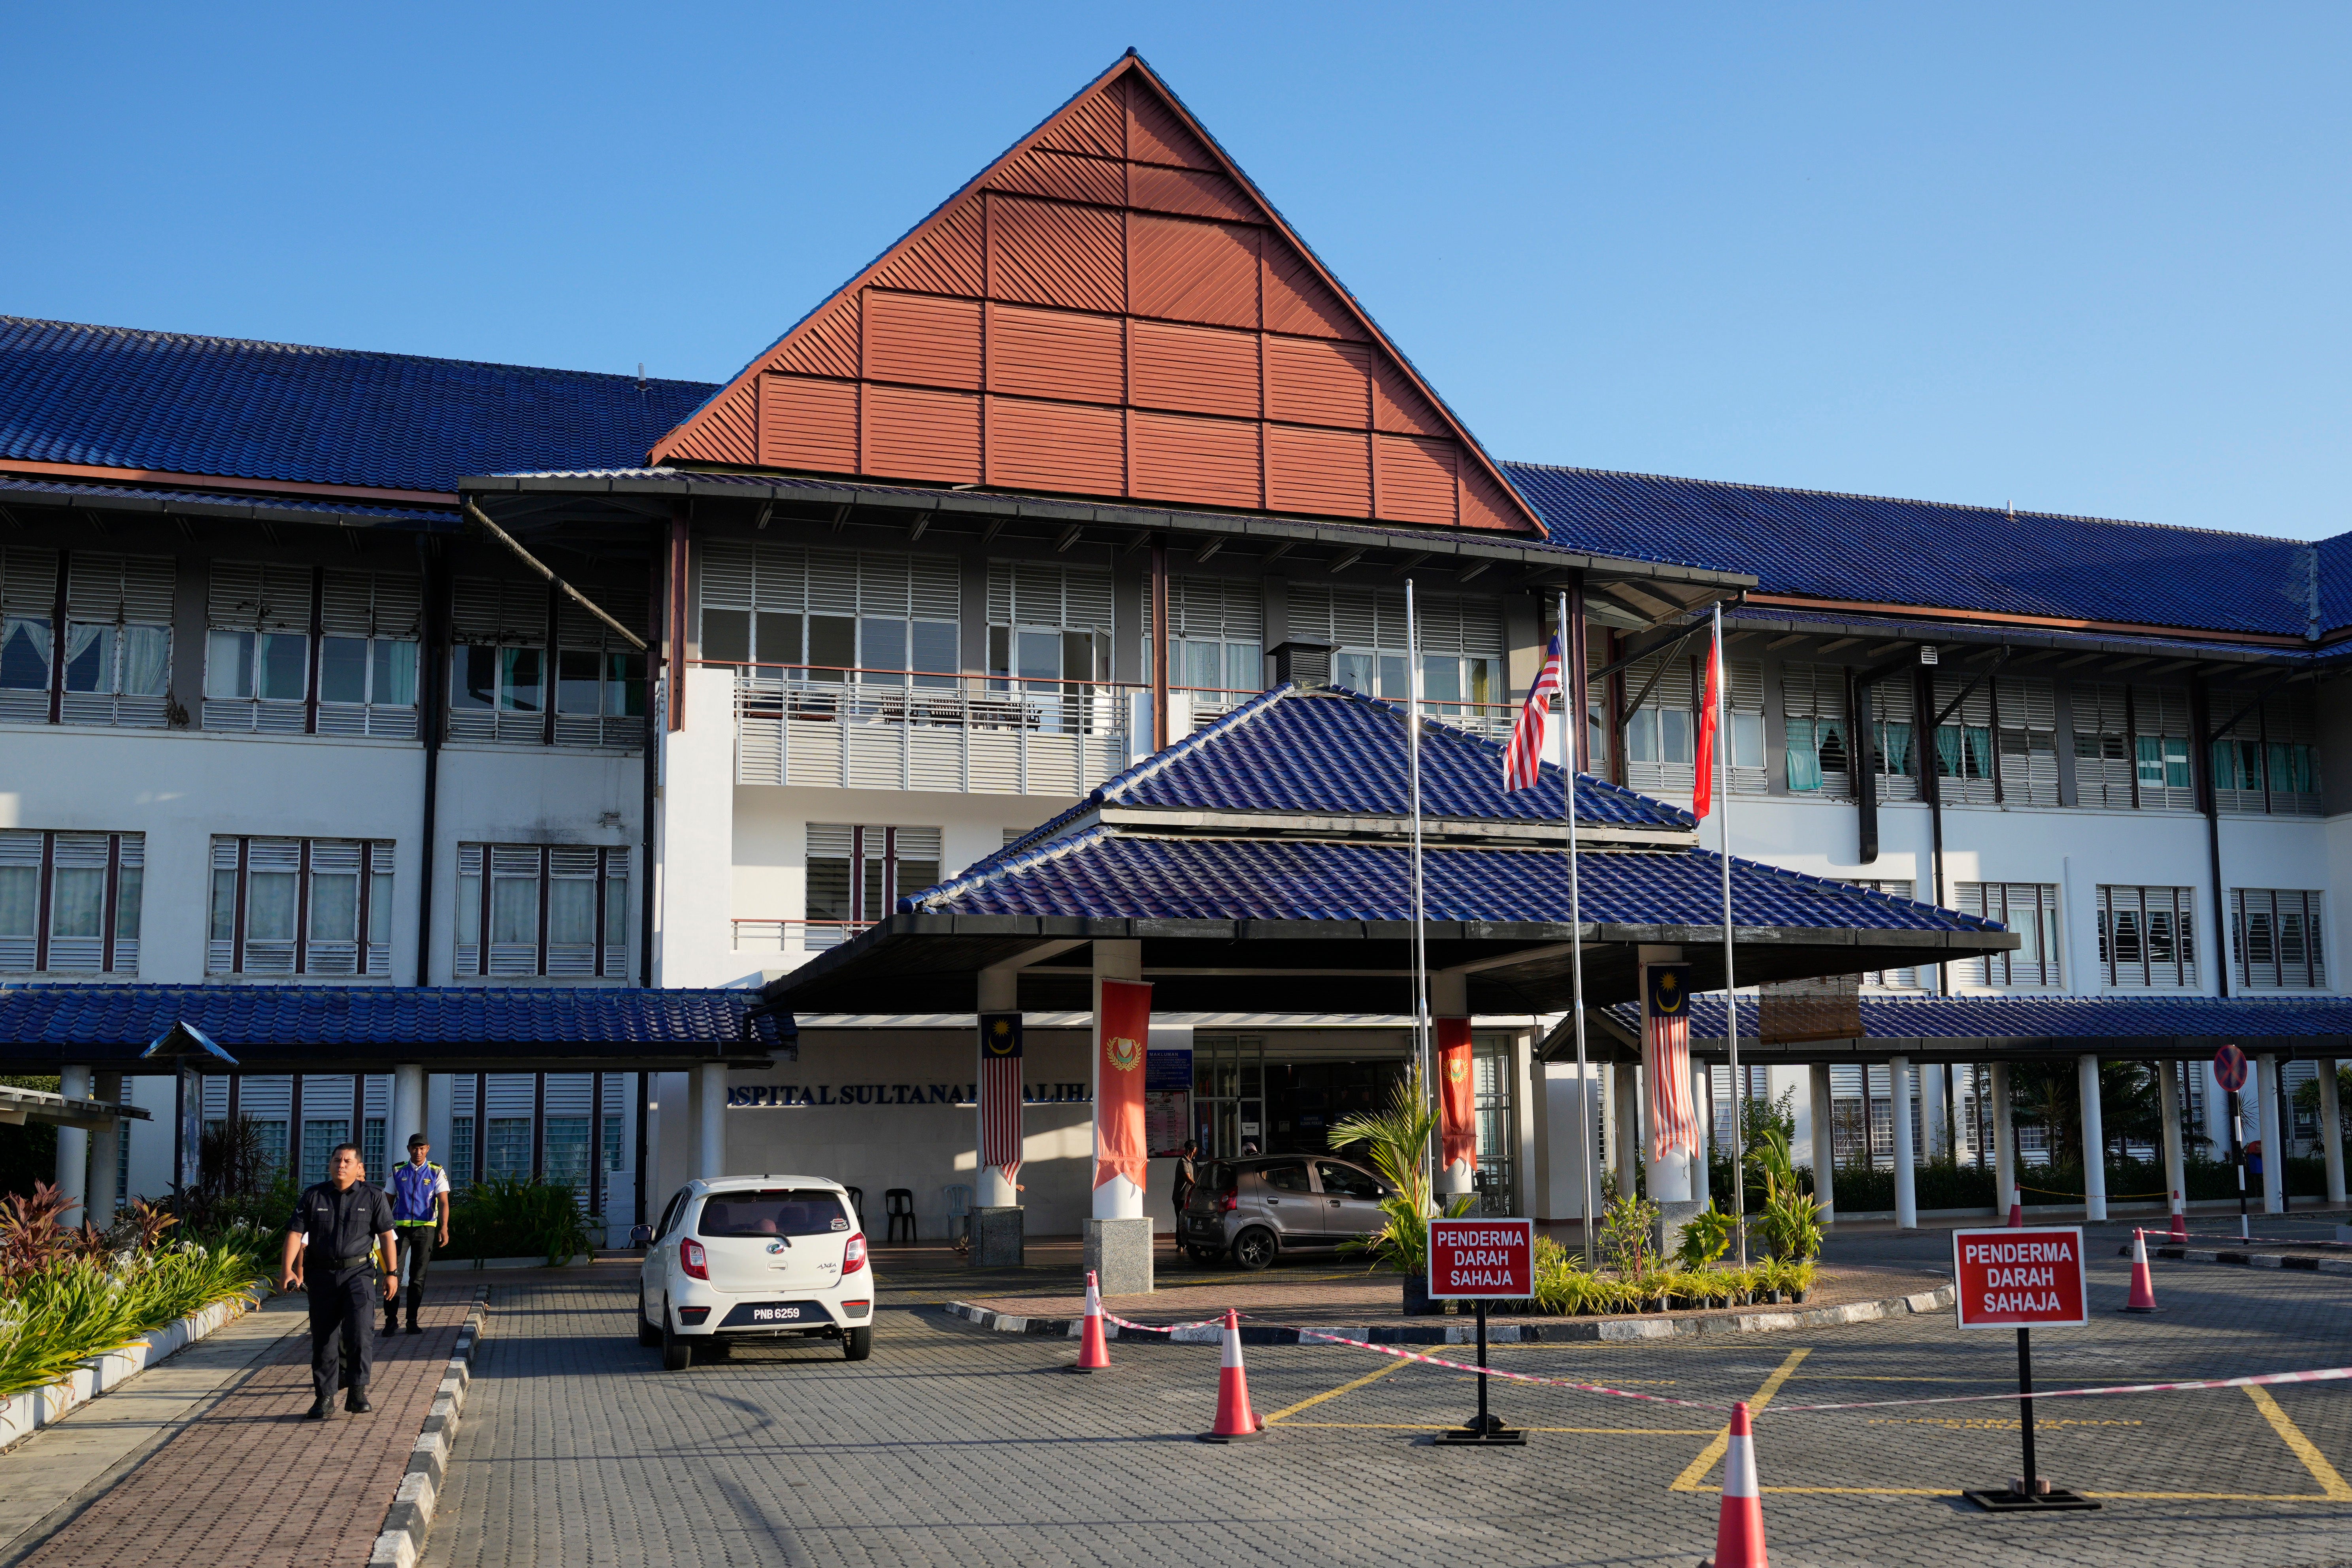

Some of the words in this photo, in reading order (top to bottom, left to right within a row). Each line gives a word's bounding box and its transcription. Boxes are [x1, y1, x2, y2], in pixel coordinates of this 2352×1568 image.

[1438, 1231, 1524, 1246] PENDERMA
[1455, 1250, 1508, 1266] DARAH
[1965, 1242, 2073, 1264] PENDERMA
[1450, 1270, 1513, 1286] SAHAJA
[1987, 1267, 2054, 1287] DARAH
[1984, 1292, 2061, 1312] SAHAJA
[754, 1309, 773, 1320] PNB
[774, 1308, 800, 1319] 6259
